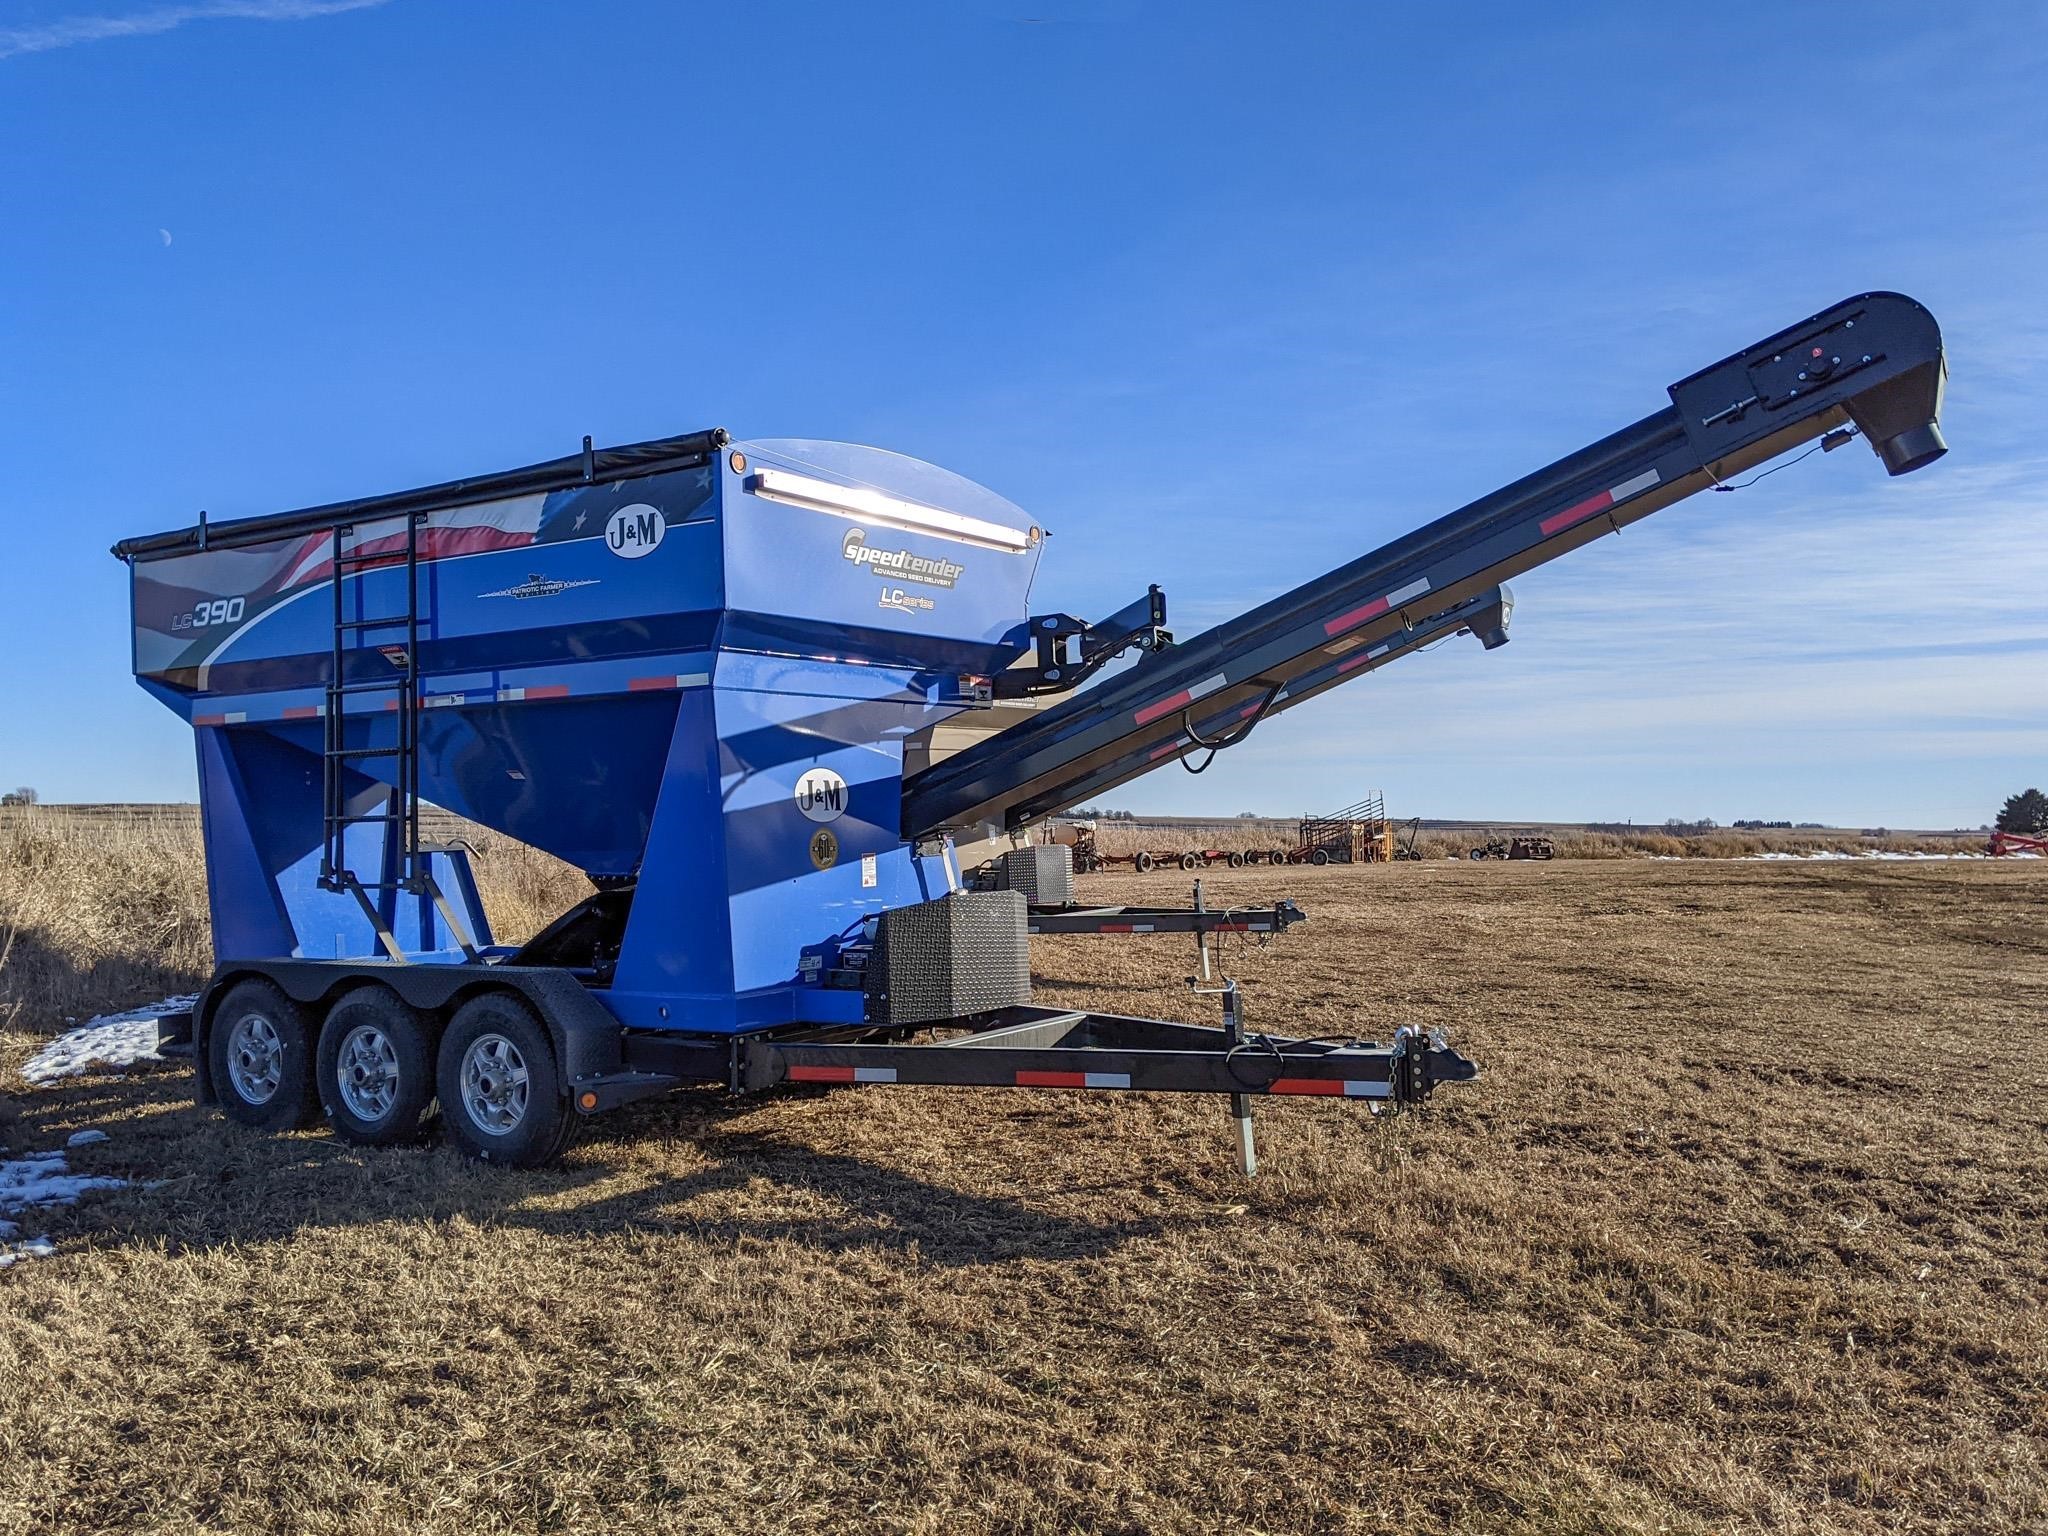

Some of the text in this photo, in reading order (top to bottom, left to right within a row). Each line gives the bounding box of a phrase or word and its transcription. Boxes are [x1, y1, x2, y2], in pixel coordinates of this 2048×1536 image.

[609, 513, 657, 549] J&M
[511, 583, 563, 595] PATRIOTIC FARMER
[873, 567, 952, 587] ADVANCED SEED DELIVERY
[800, 779, 842, 811] J&M
